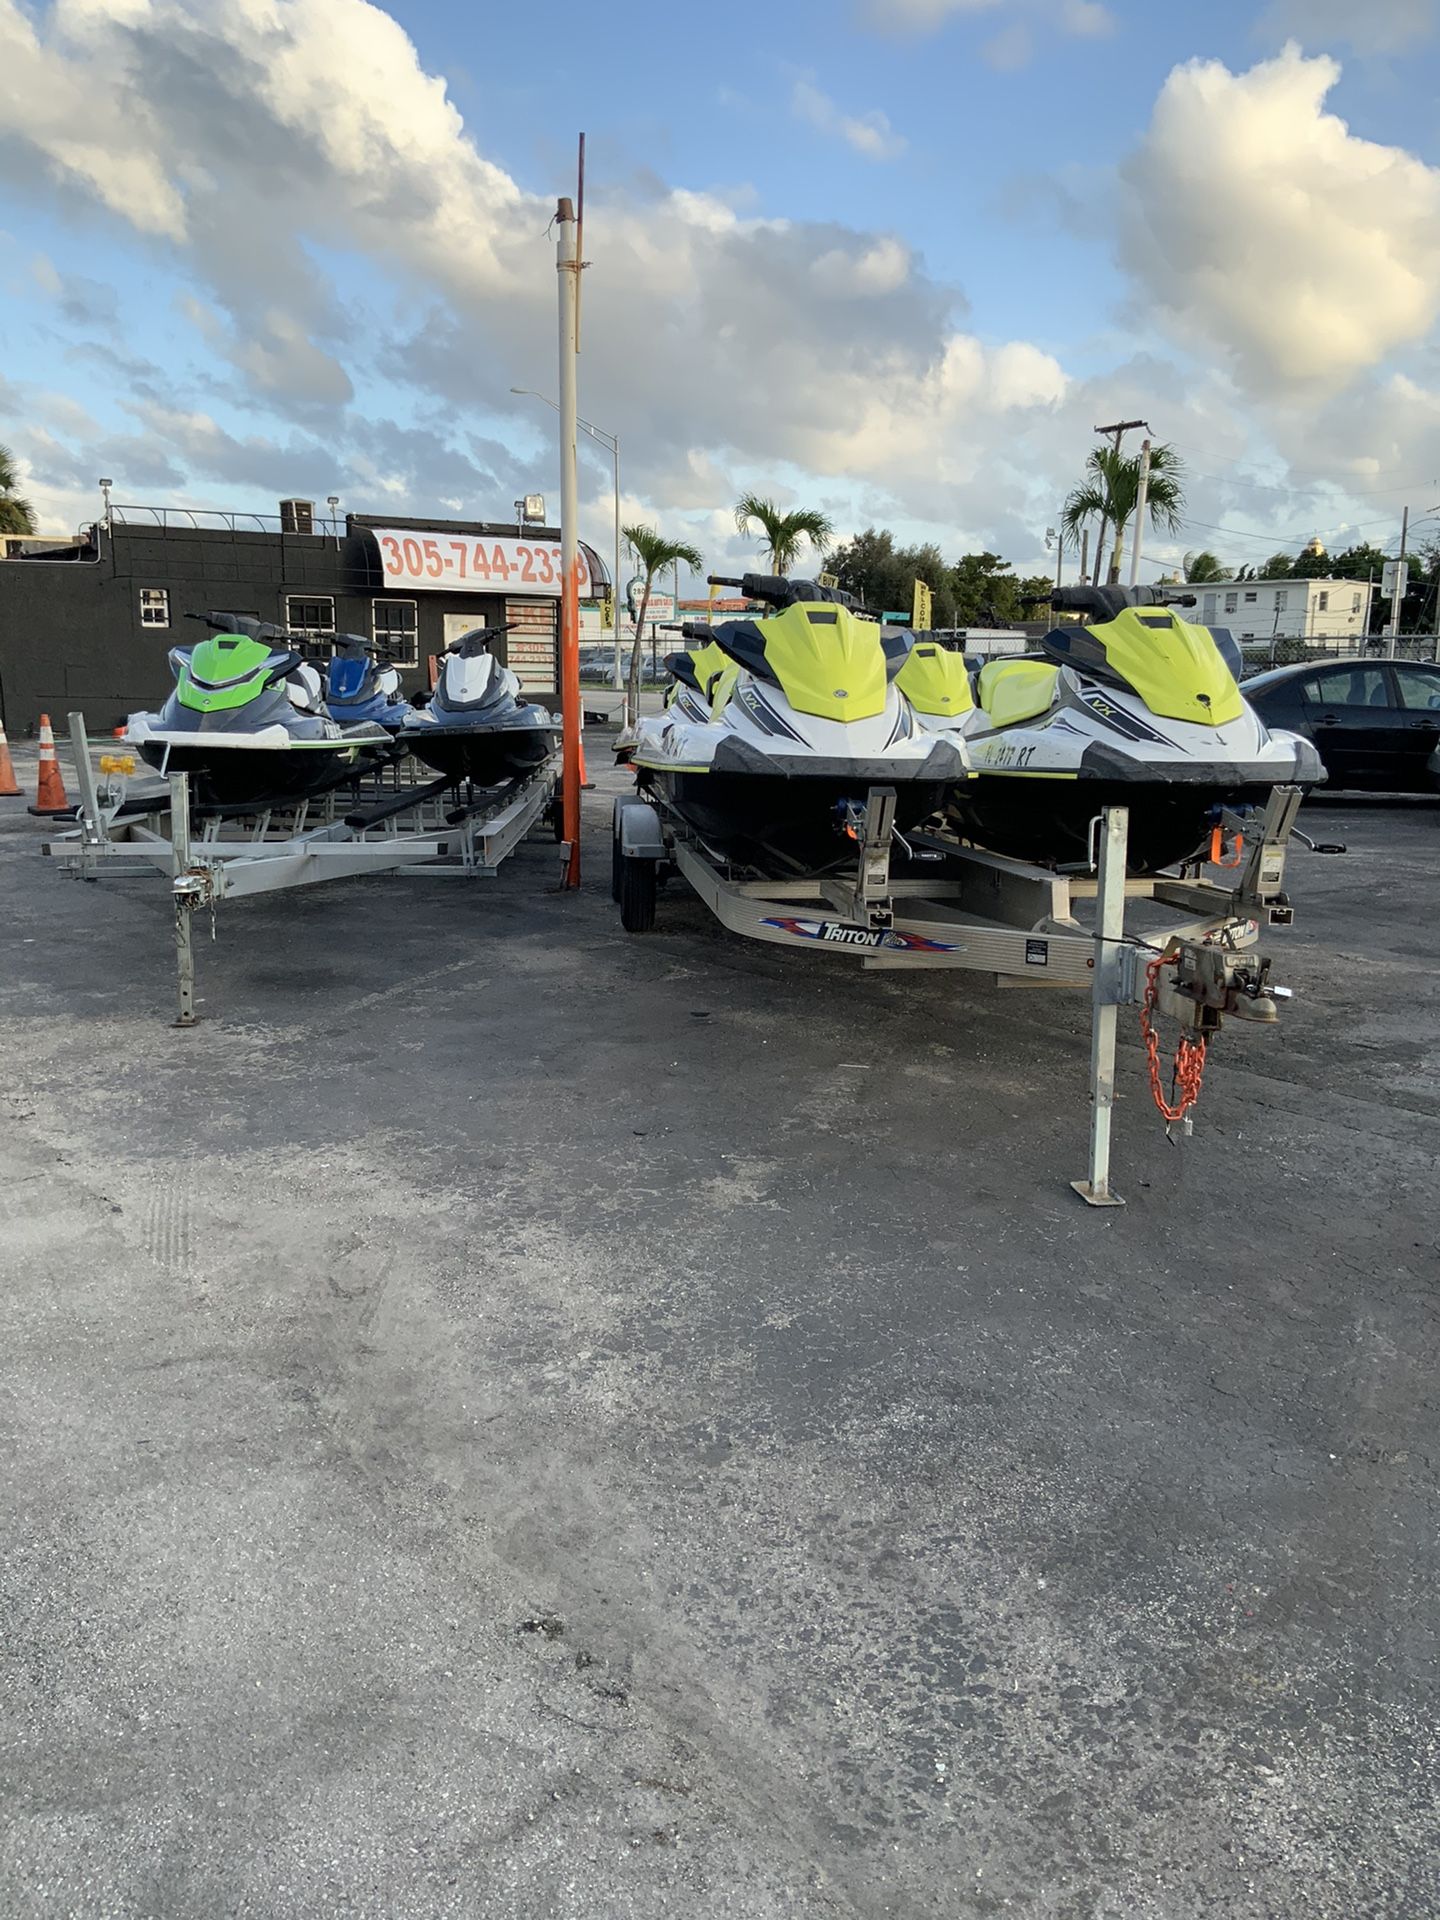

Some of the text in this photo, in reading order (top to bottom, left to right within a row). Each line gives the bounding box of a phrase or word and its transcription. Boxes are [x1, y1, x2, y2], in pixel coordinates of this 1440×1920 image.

[822, 576, 836, 587] BUY
[919, 584, 927, 629] WELCOME
[744, 693, 761, 710] VX
[1091, 699, 1117, 717] VX
[1016, 745, 1037, 767] RT
[824, 922, 881, 946] TRITON
